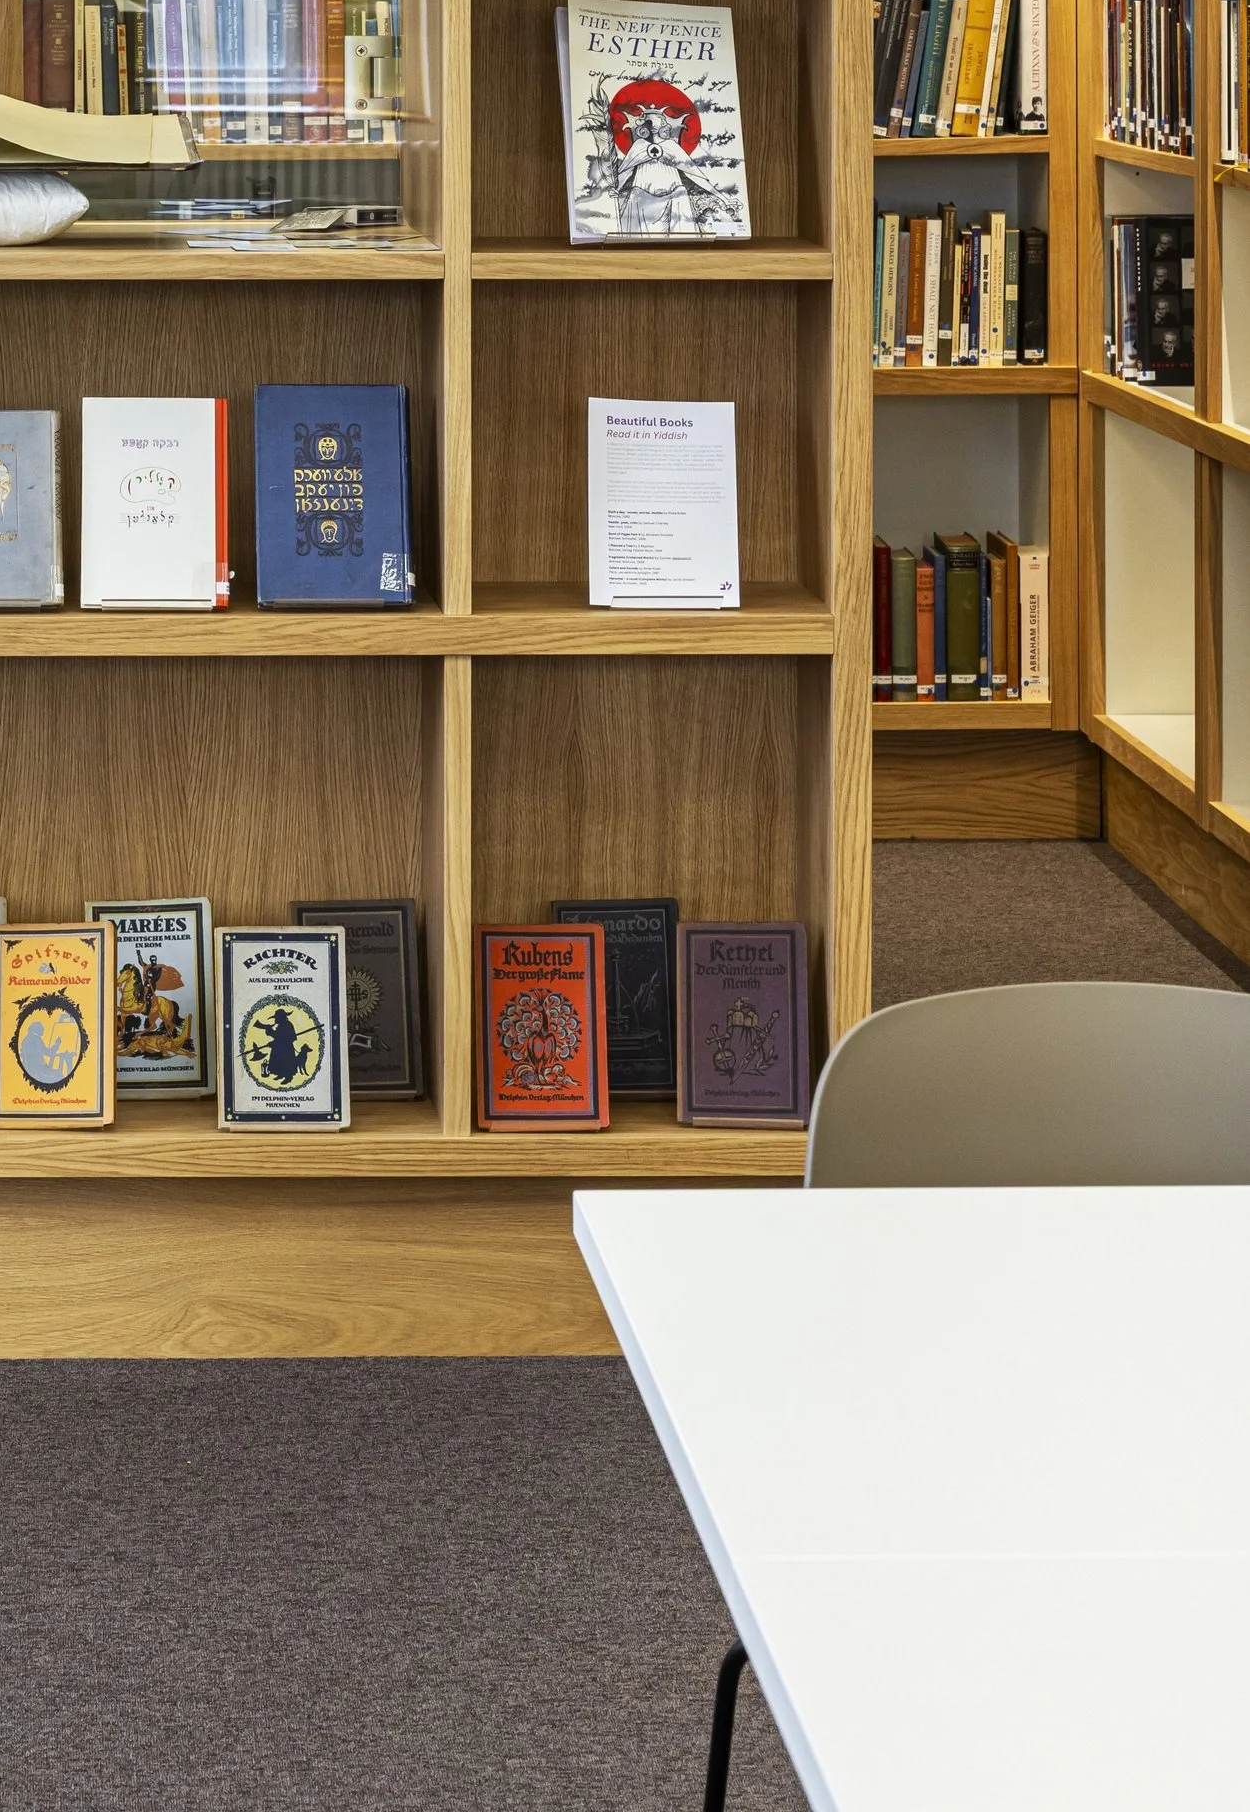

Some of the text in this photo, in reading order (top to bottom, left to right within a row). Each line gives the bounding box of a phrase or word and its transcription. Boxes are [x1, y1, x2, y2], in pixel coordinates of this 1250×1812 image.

[579, 14, 610, 30] THE
[616, 20, 656, 34] NEW
[659, 24, 722, 38] VENICE
[587, 32, 716, 61] ESTHER
[932, 22, 944, 57] LIGHT
[1031, 48, 1040, 92] ANXIETY
[606, 415, 694, 428] Beautiful Books
[606, 429, 688, 440] Read it in Yiddish
[333, 466, 363, 482] אלע
[294, 484, 364, 498] פון יעקב
[1029, 594, 1037, 625] GEIGER
[108, 915, 187, 933] MARÉES
[243, 948, 318, 970] RICHTER
[502, 940, 573, 966] Rubens
[710, 939, 774, 965] Rethel
[493, 967, 517, 980] Der
[550, 968, 585, 983] Flame
[765, 964, 786, 975] und
[8, 975, 91, 986] Reime und Bilder
[12, 1097, 39, 1105] Delphin
[498, 1093, 528, 1102] Delphin
